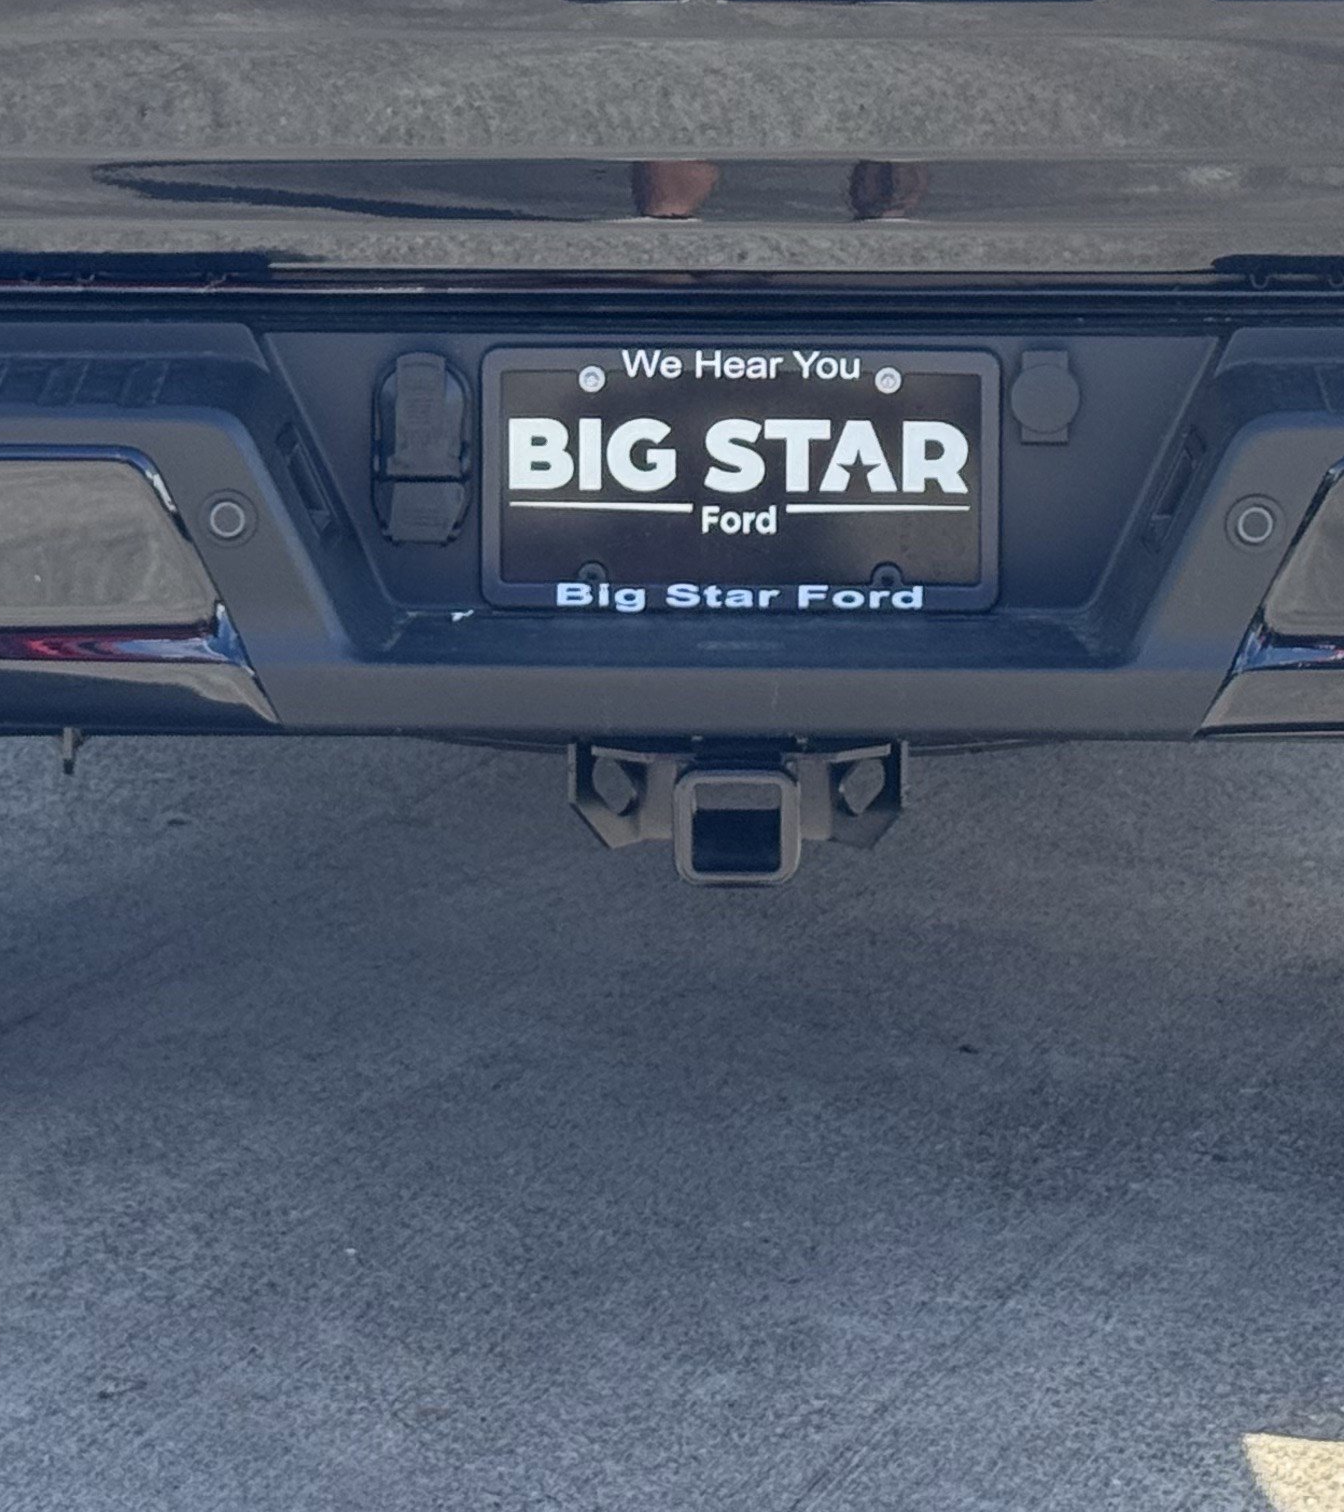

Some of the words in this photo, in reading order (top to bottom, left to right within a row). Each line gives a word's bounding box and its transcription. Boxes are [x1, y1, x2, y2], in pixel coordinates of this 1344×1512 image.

[621, 348, 683, 379] We
[694, 349, 784, 380] Hear
[792, 349, 861, 381] You
[508, 417, 677, 492] BIG
[703, 418, 970, 495] STAR
[701, 504, 778, 535] Ford
[555, 582, 647, 613] Big
[665, 582, 781, 610] Star
[797, 584, 924, 611] Ford
